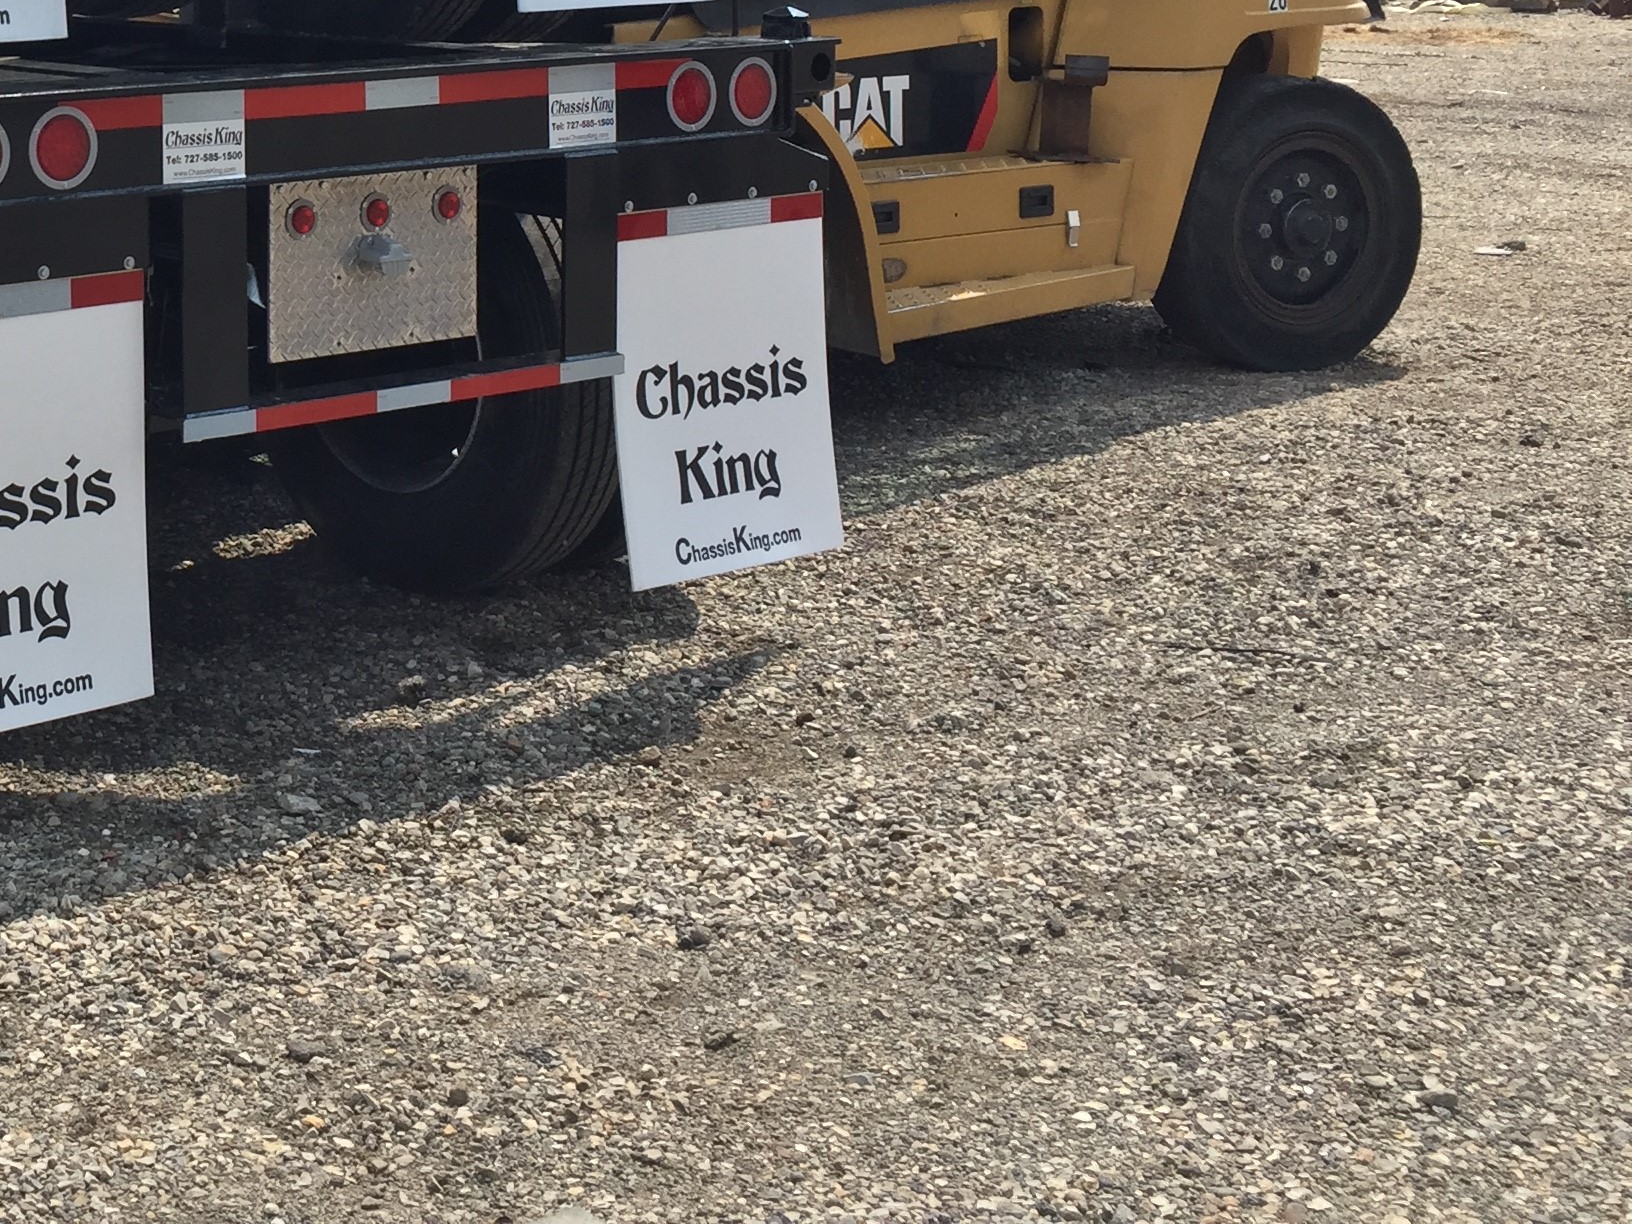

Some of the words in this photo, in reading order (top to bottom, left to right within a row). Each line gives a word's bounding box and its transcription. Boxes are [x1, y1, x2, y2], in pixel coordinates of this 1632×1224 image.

[551, 97, 590, 115] Chassis
[590, 96, 615, 113] King
[822, 74, 911, 147] CAT
[165, 128, 213, 148] Chassis
[214, 126, 243, 146] King
[184, 151, 243, 163] 727-585-1500
[635, 344, 808, 420] Chassis
[674, 440, 782, 505] King
[675, 525, 802, 566] ChassisKing.com
